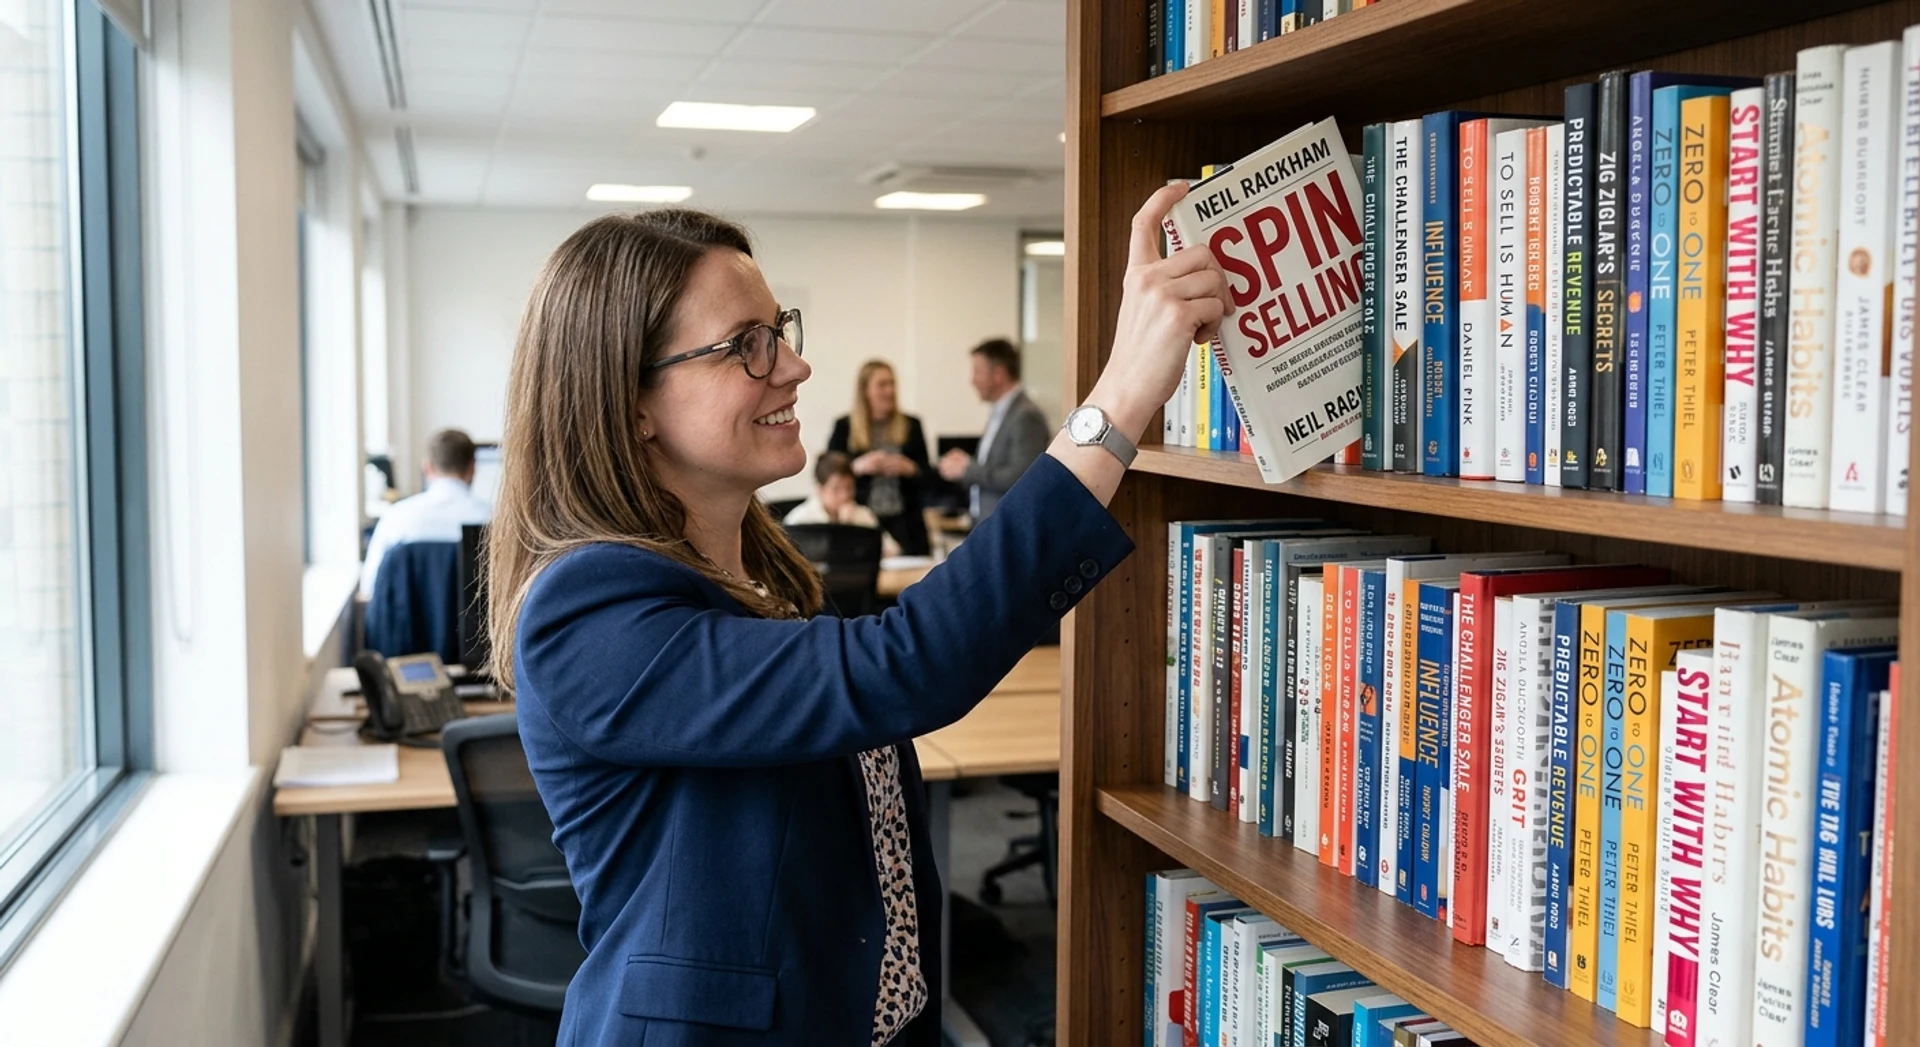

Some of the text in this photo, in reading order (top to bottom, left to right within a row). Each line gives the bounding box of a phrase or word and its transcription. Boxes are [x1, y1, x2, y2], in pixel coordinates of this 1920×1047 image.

[1194, 137, 1332, 223] NEIL RACKHAM
[1500, 152, 1515, 180] TO
[1654, 128, 1673, 206] ZERO
[1684, 123, 1705, 204] ZERO
[1730, 104, 1760, 205] START
[1208, 169, 1363, 308] SPIN
[1395, 136, 1408, 331] THE CHALLENGER SALE
[1500, 189, 1514, 235] SELL
[1566, 117, 1585, 335] PREDICTABLE REVENUE
[1795, 122, 1830, 274] Atomic
[1424, 220, 1445, 325] INFLUENCE
[1500, 245, 1514, 263] IS
[1594, 151, 1617, 373] ZIG ZIGLAR'S SECRETS
[1651, 233, 1672, 299] ONE
[1682, 232, 1704, 299] ONE
[1728, 216, 1759, 300] WITH
[1726, 311, 1757, 386] WHY
[1790, 287, 1826, 418] Habits
[1283, 410, 1325, 445] NEIL
[1461, 592, 1475, 626] THE
[1582, 629, 1600, 706] ZERO
[1606, 644, 1625, 721] ZERO
[1628, 636, 1648, 716] ZERO
[1418, 659, 1442, 769] INFLUENCE
[1675, 667, 1710, 773] START
[1766, 674, 1803, 821] Atomic
[1456, 748, 1472, 793] SALE
[1511, 768, 1528, 829] GRIT
[1579, 734, 1598, 799] ONE
[1604, 746, 1623, 811] ONE
[1625, 743, 1645, 811] ONE
[1671, 780, 1707, 868] WITH
[1668, 876, 1702, 957] WHY
[1761, 830, 1798, 962] Habits
[1708, 911, 1724, 1015] James Clear
